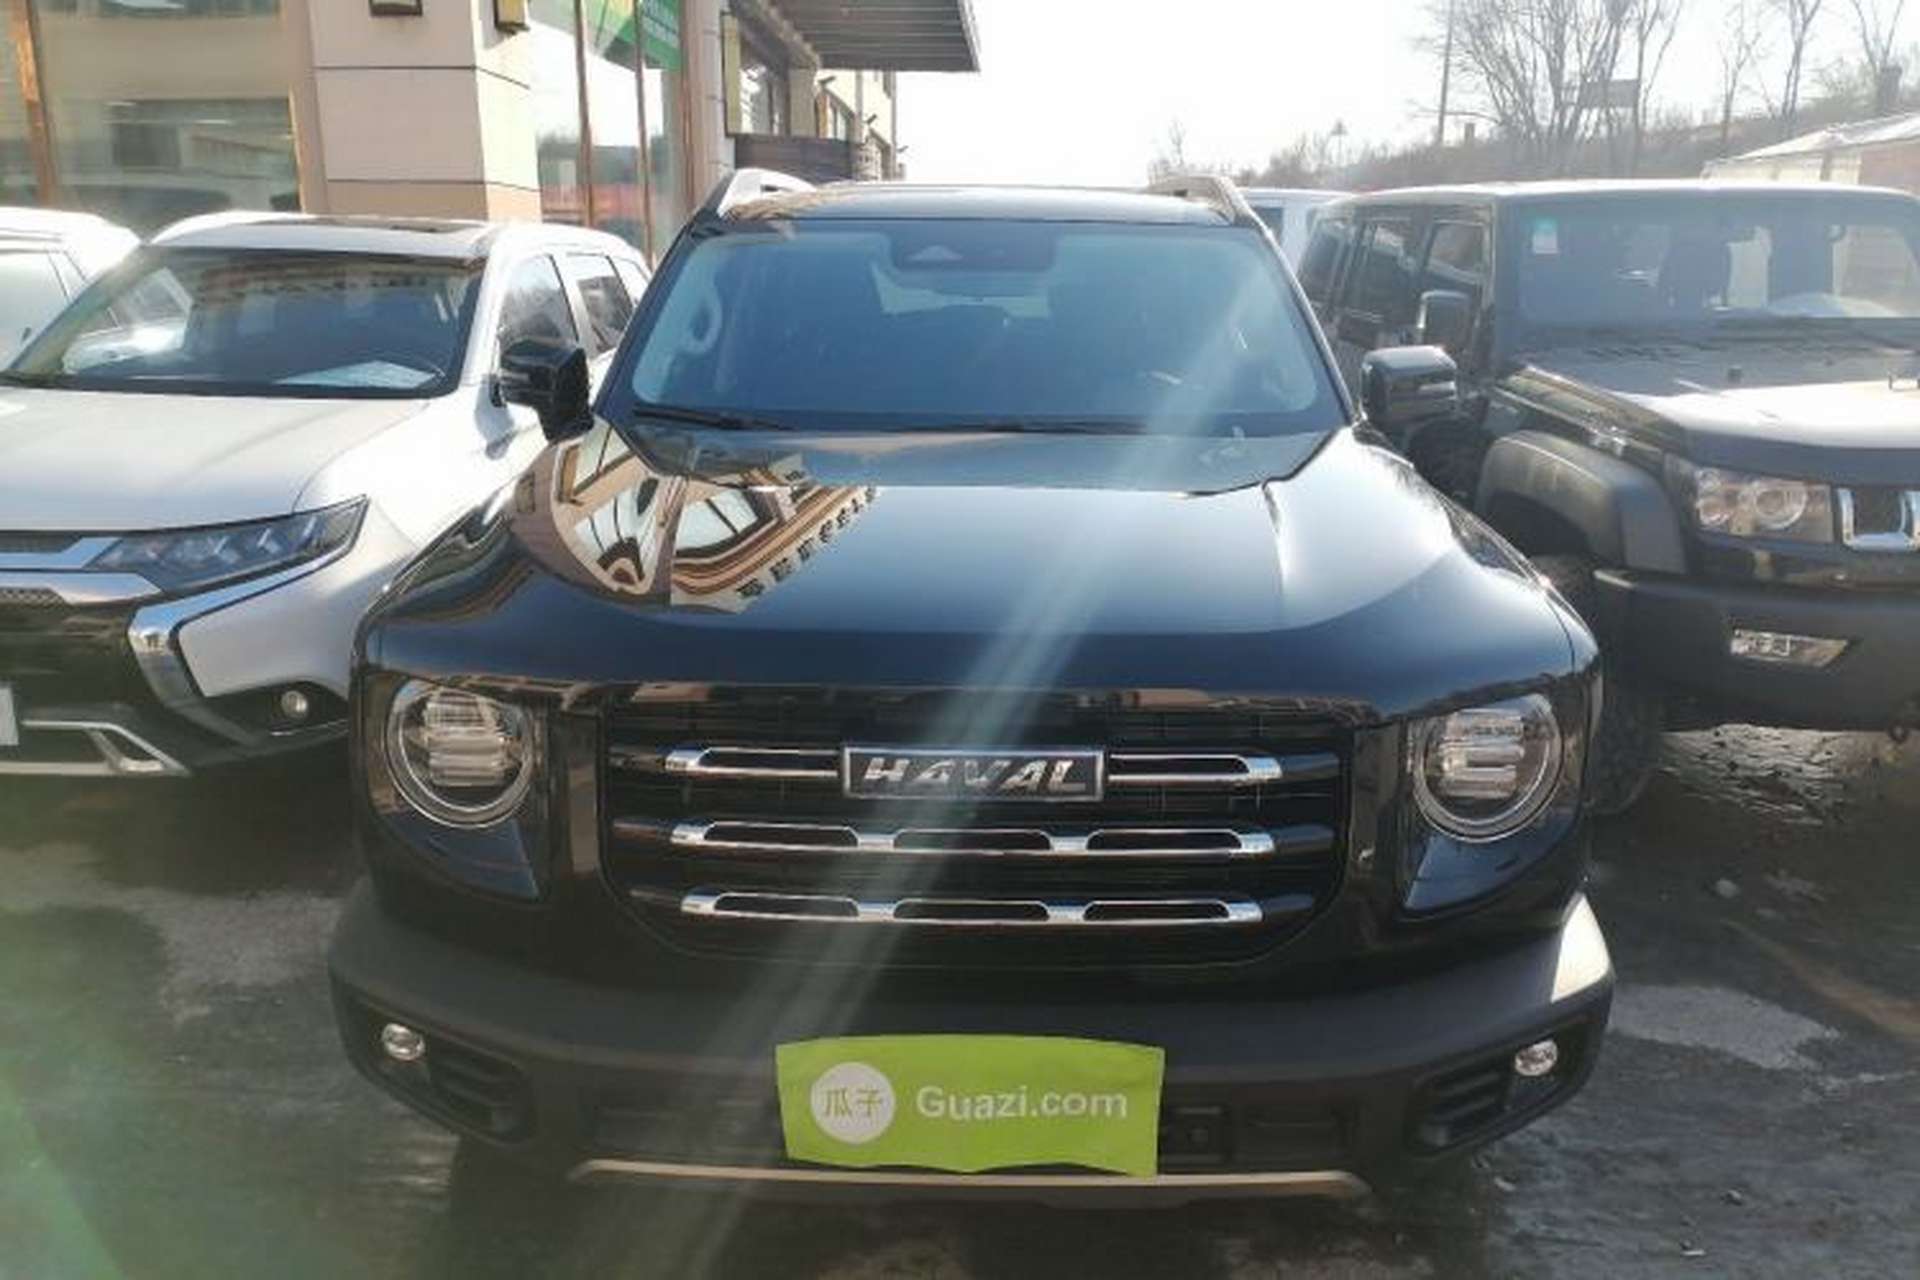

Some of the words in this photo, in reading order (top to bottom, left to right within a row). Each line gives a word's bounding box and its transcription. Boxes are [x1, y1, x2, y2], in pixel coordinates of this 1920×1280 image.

[863, 757, 1086, 793] HAVAL
[823, 1087, 883, 1118] 瓜子
[916, 1085, 1128, 1121] Guazi.com
